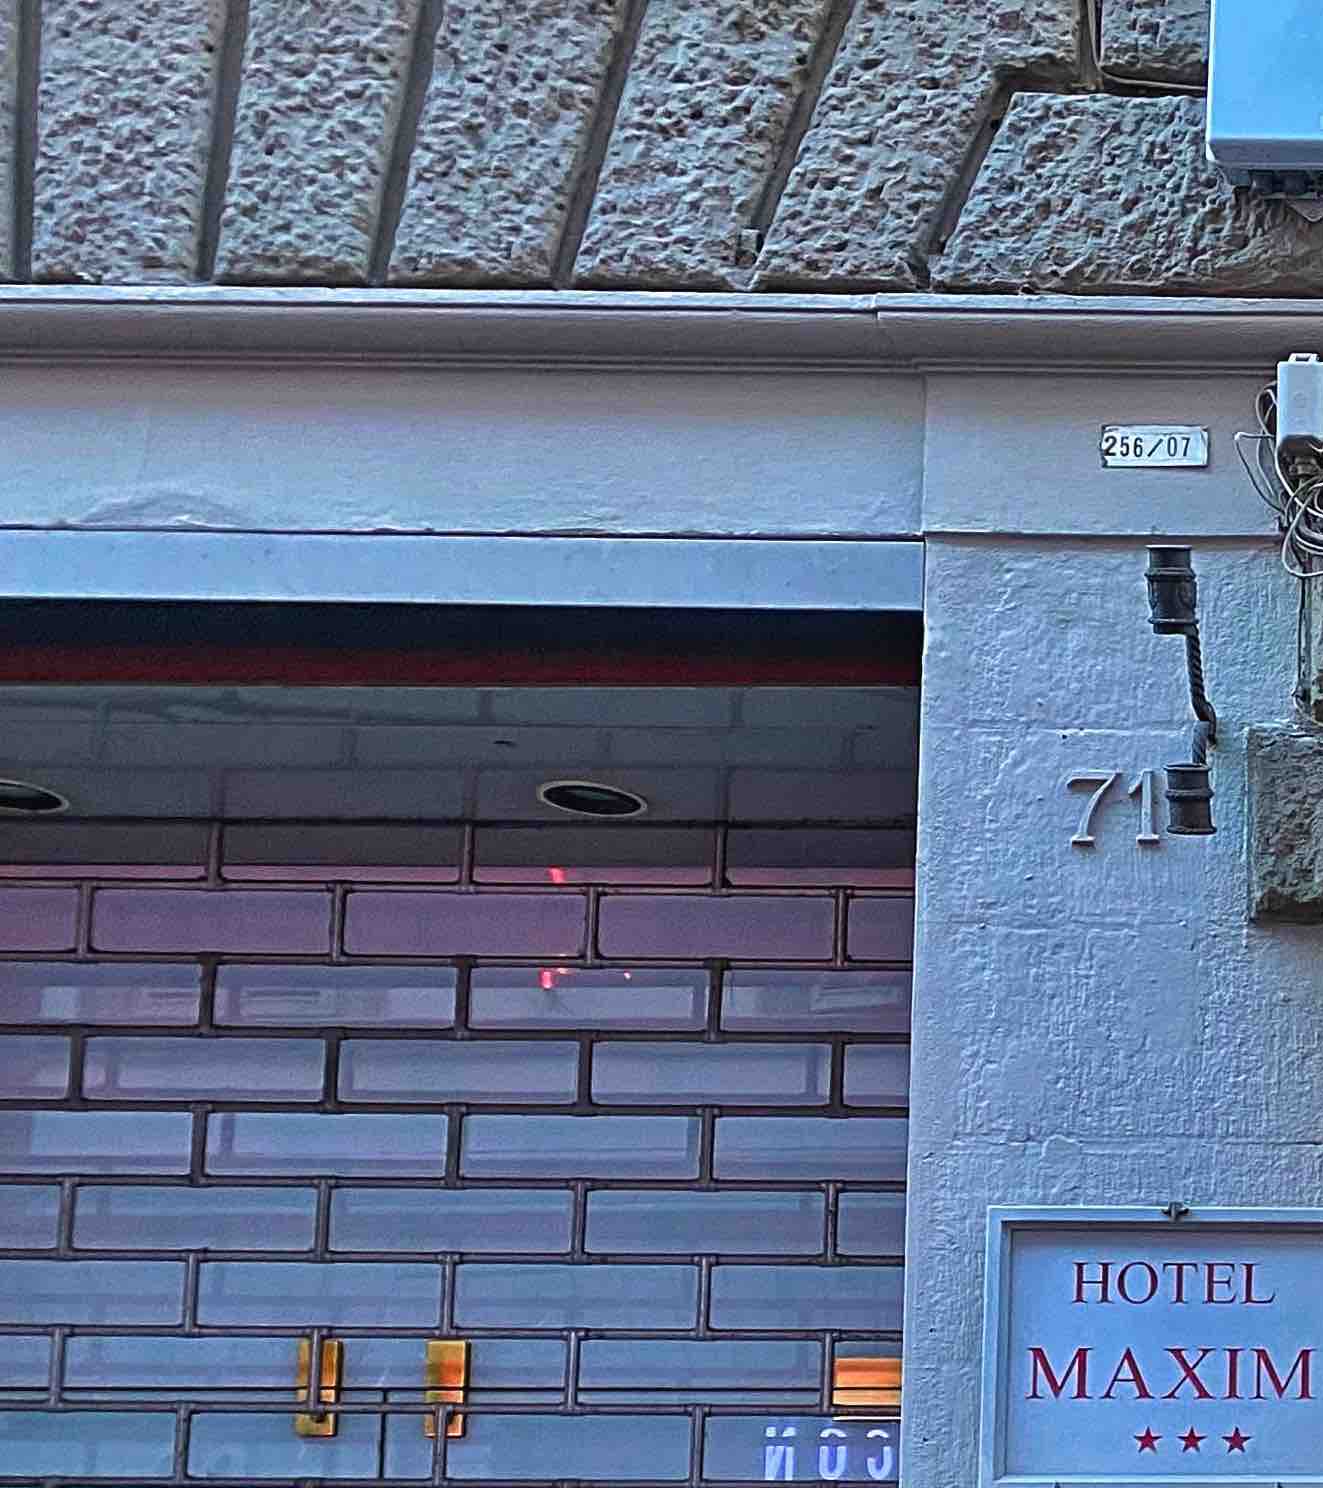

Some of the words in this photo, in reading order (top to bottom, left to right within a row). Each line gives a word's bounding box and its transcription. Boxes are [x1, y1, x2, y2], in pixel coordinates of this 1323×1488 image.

[1103, 435, 1191, 458] 256/07
[1066, 768, 1162, 849] 71
[1072, 1261, 1277, 1305] HOTEL
[1025, 1346, 1318, 1400] MAXIM
